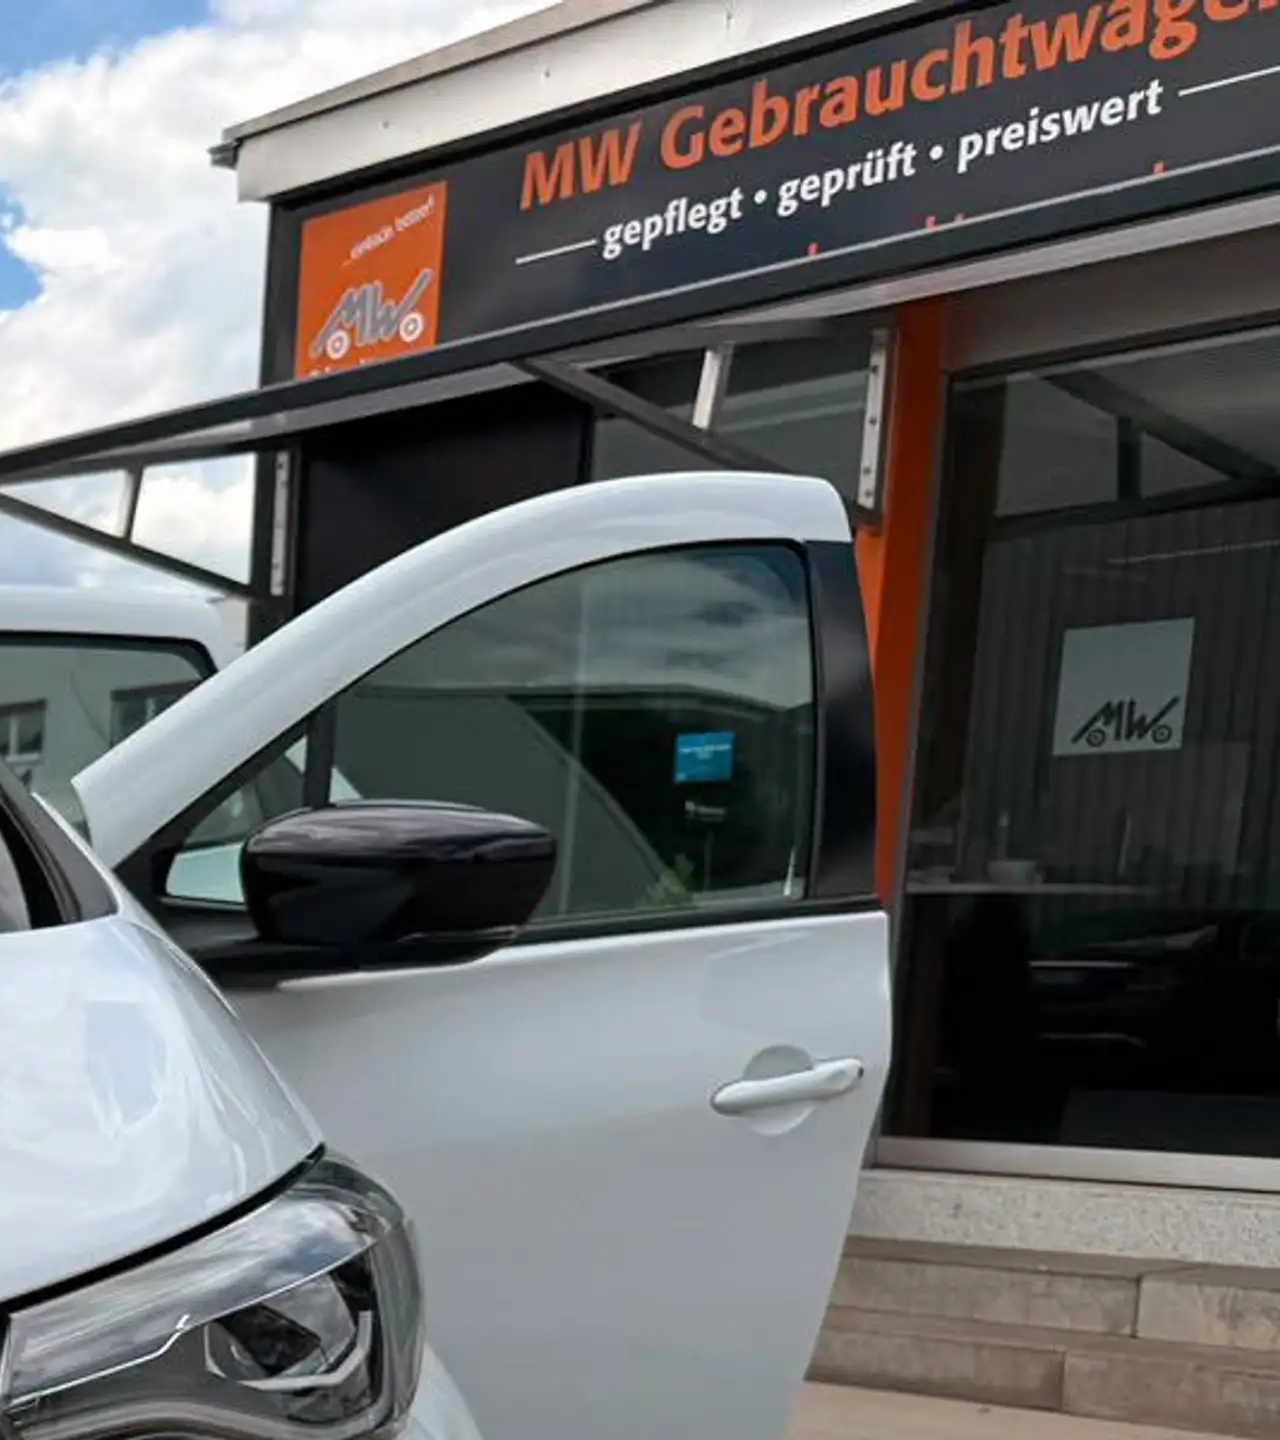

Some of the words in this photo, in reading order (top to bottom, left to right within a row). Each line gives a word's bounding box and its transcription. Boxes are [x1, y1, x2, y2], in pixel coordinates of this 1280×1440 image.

[519, 119, 643, 212] MW
[659, 0, 1279, 170] Gebrauchtwag
[602, 187, 744, 260] gepflegt
[777, 140, 917, 217] geprüft
[957, 79, 1164, 174] preiswert
[309, 268, 435, 360] MW
[1070, 694, 1182, 746] MW
